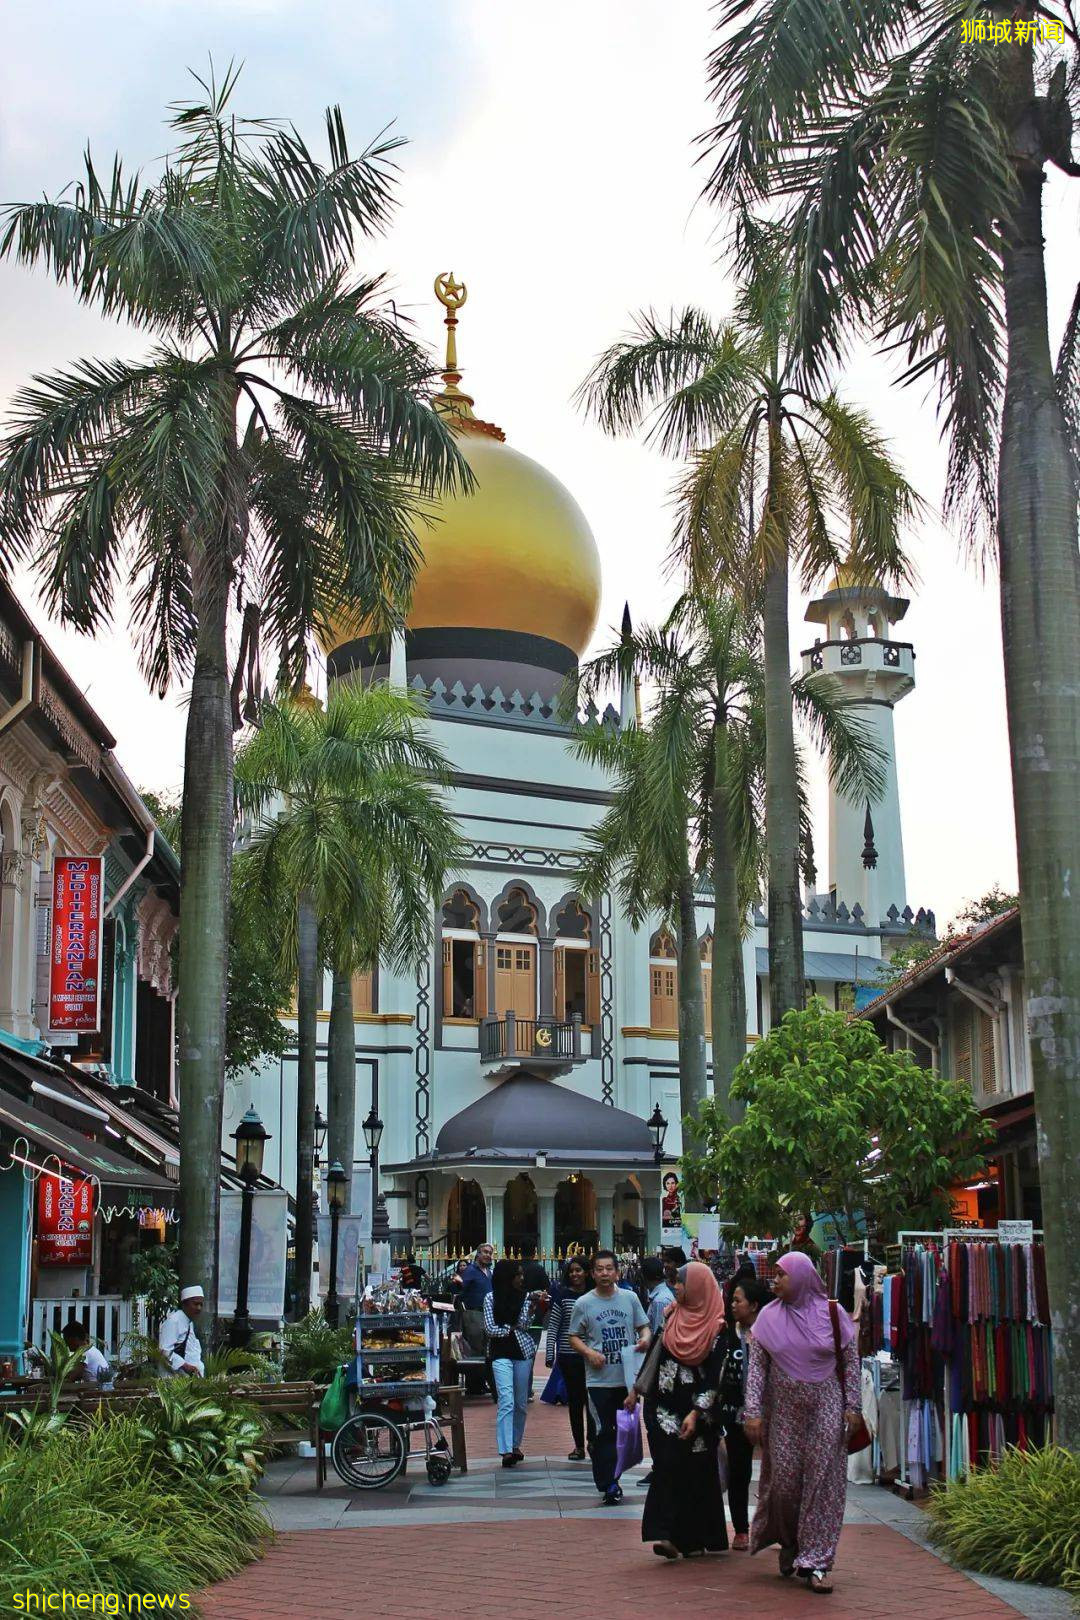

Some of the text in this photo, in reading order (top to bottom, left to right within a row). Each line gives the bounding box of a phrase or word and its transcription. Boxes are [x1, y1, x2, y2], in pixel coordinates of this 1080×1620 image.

[66, 862, 89, 991] MEDITERRANEAN
[601, 1326, 626, 1340] SURF
[604, 1352, 623, 1364] TEA
